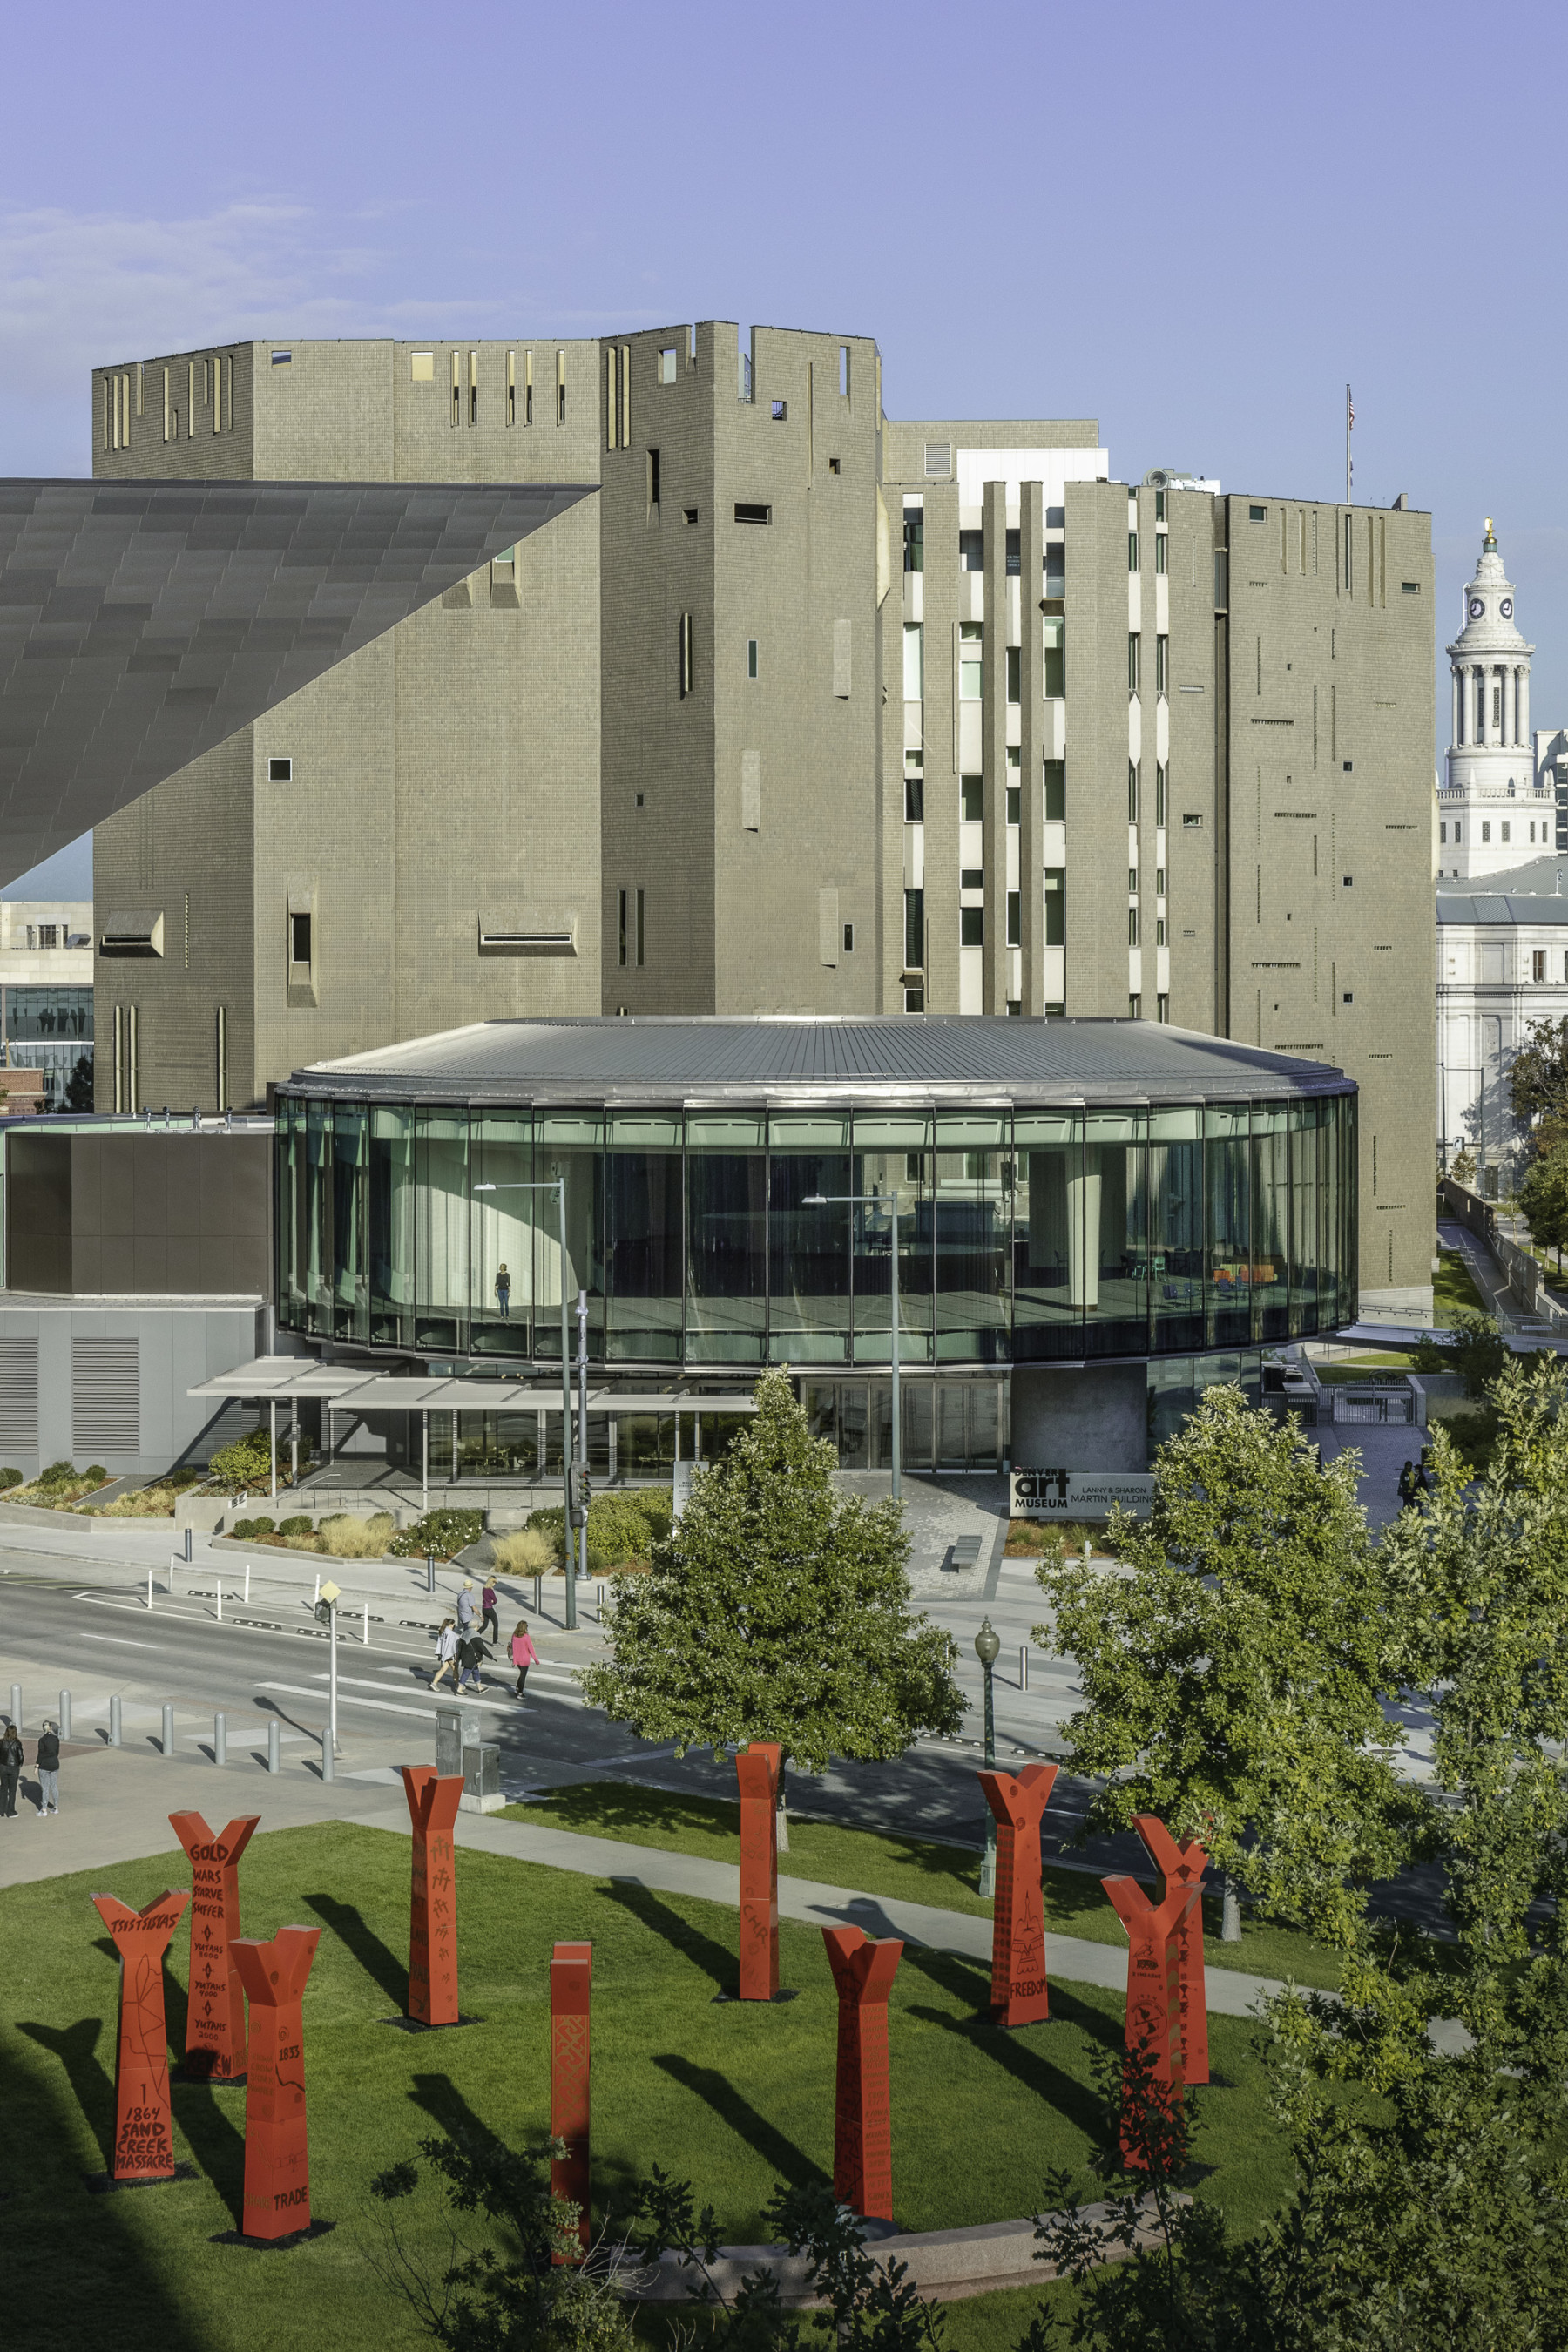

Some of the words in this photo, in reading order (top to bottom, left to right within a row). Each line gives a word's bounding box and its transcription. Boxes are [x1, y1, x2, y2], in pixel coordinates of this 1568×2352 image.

[1015, 1467, 1058, 1477] DENVER
[1015, 1469, 1070, 1498] art
[1015, 1499, 1068, 1509] MUSEUM
[1111, 1495, 1156, 1504] BUILDING
[190, 1843, 229, 1862] GOLD
[193, 1869, 221, 1884] WARS
[193, 1885, 223, 1902] STARVE
[193, 1902, 224, 1918] SUFFER
[194, 1943, 223, 1954] YUTAHS
[194, 1980, 226, 1991] YUTAHS
[1010, 1976, 1047, 1999] FREEDOM
[194, 2018, 227, 2031] YUTAHS
[279, 2045, 300, 2061] 1833
[126, 2107, 160, 2122] 1864
[120, 2122, 166, 2139] SAND
[117, 2138, 168, 2154] CREEK
[115, 2152, 173, 2171] MASSACRE
[274, 2186, 308, 2211] TRADE
